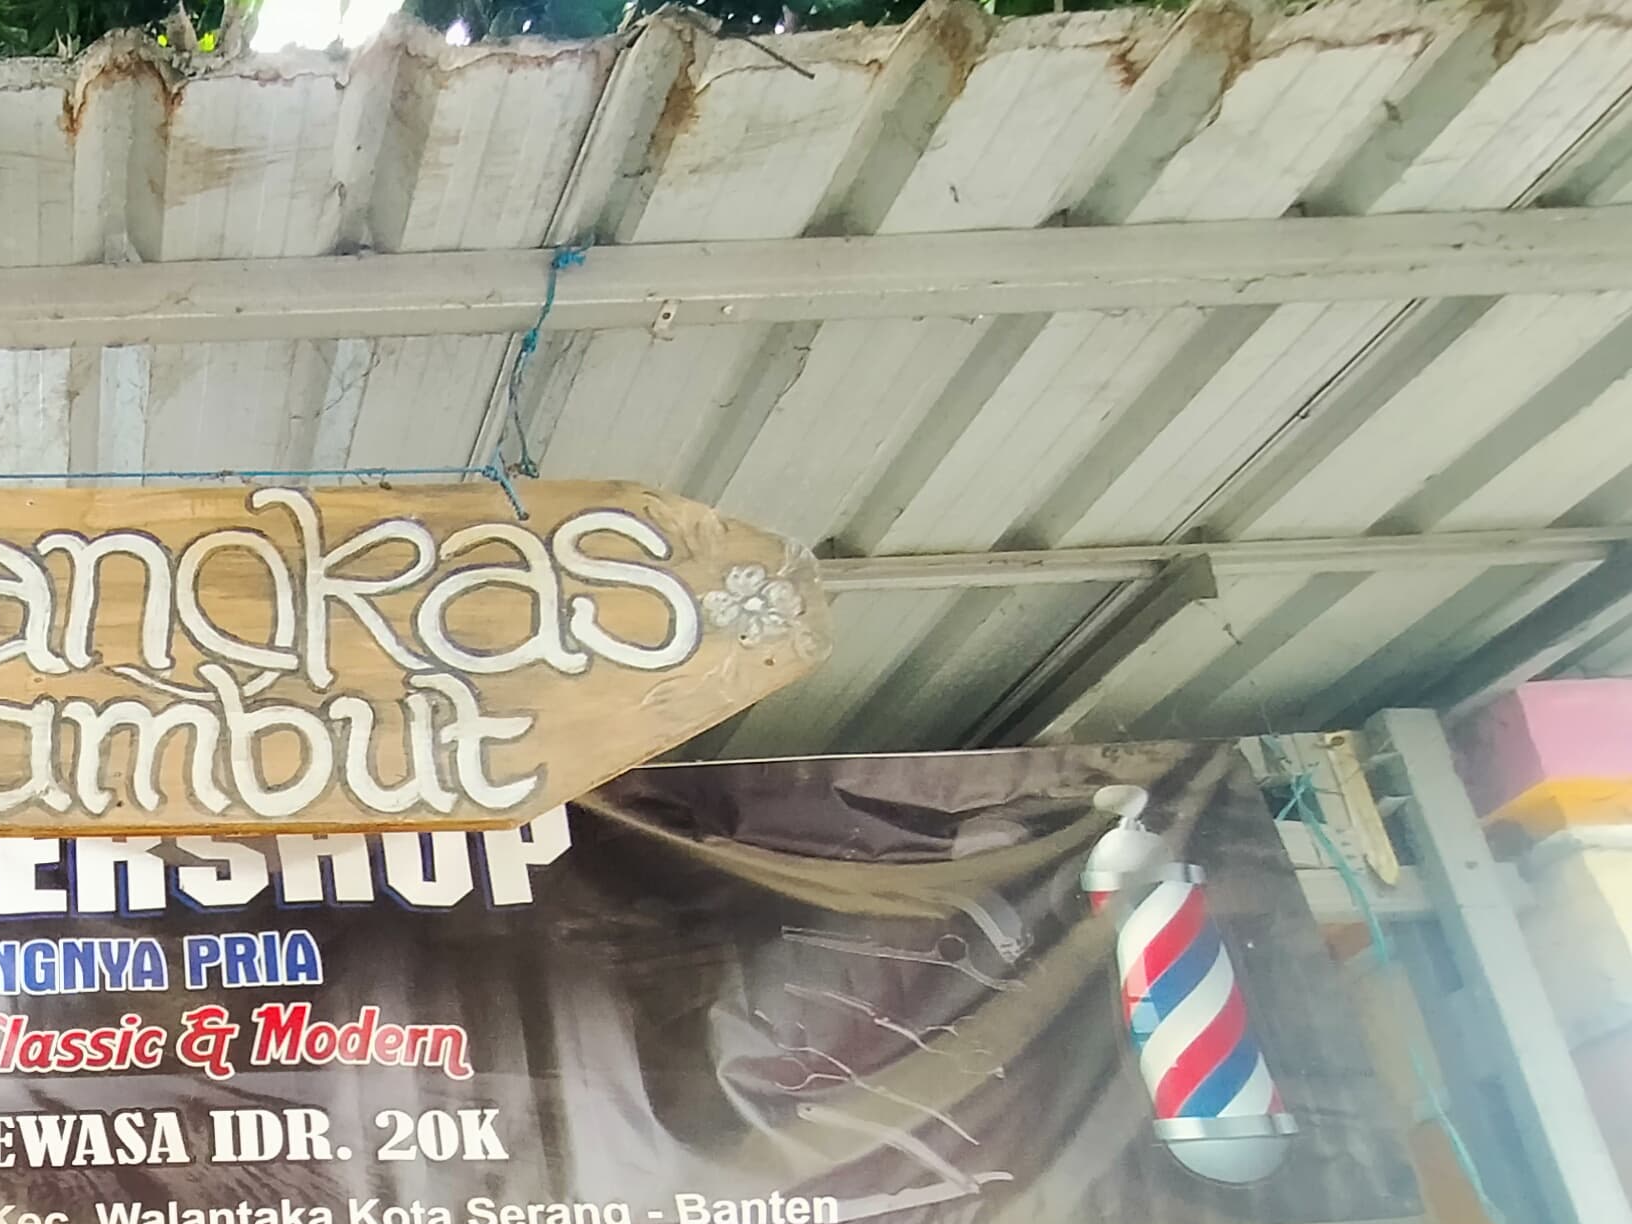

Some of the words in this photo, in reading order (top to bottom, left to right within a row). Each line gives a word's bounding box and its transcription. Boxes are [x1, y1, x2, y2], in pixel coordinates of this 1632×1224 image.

[182, 931, 324, 990] PRIA
[176, 1004, 240, 1081] &
[250, 1002, 474, 1081] Modern
[208, 1108, 353, 1163] IDR.
[373, 1107, 510, 1162] 20K
